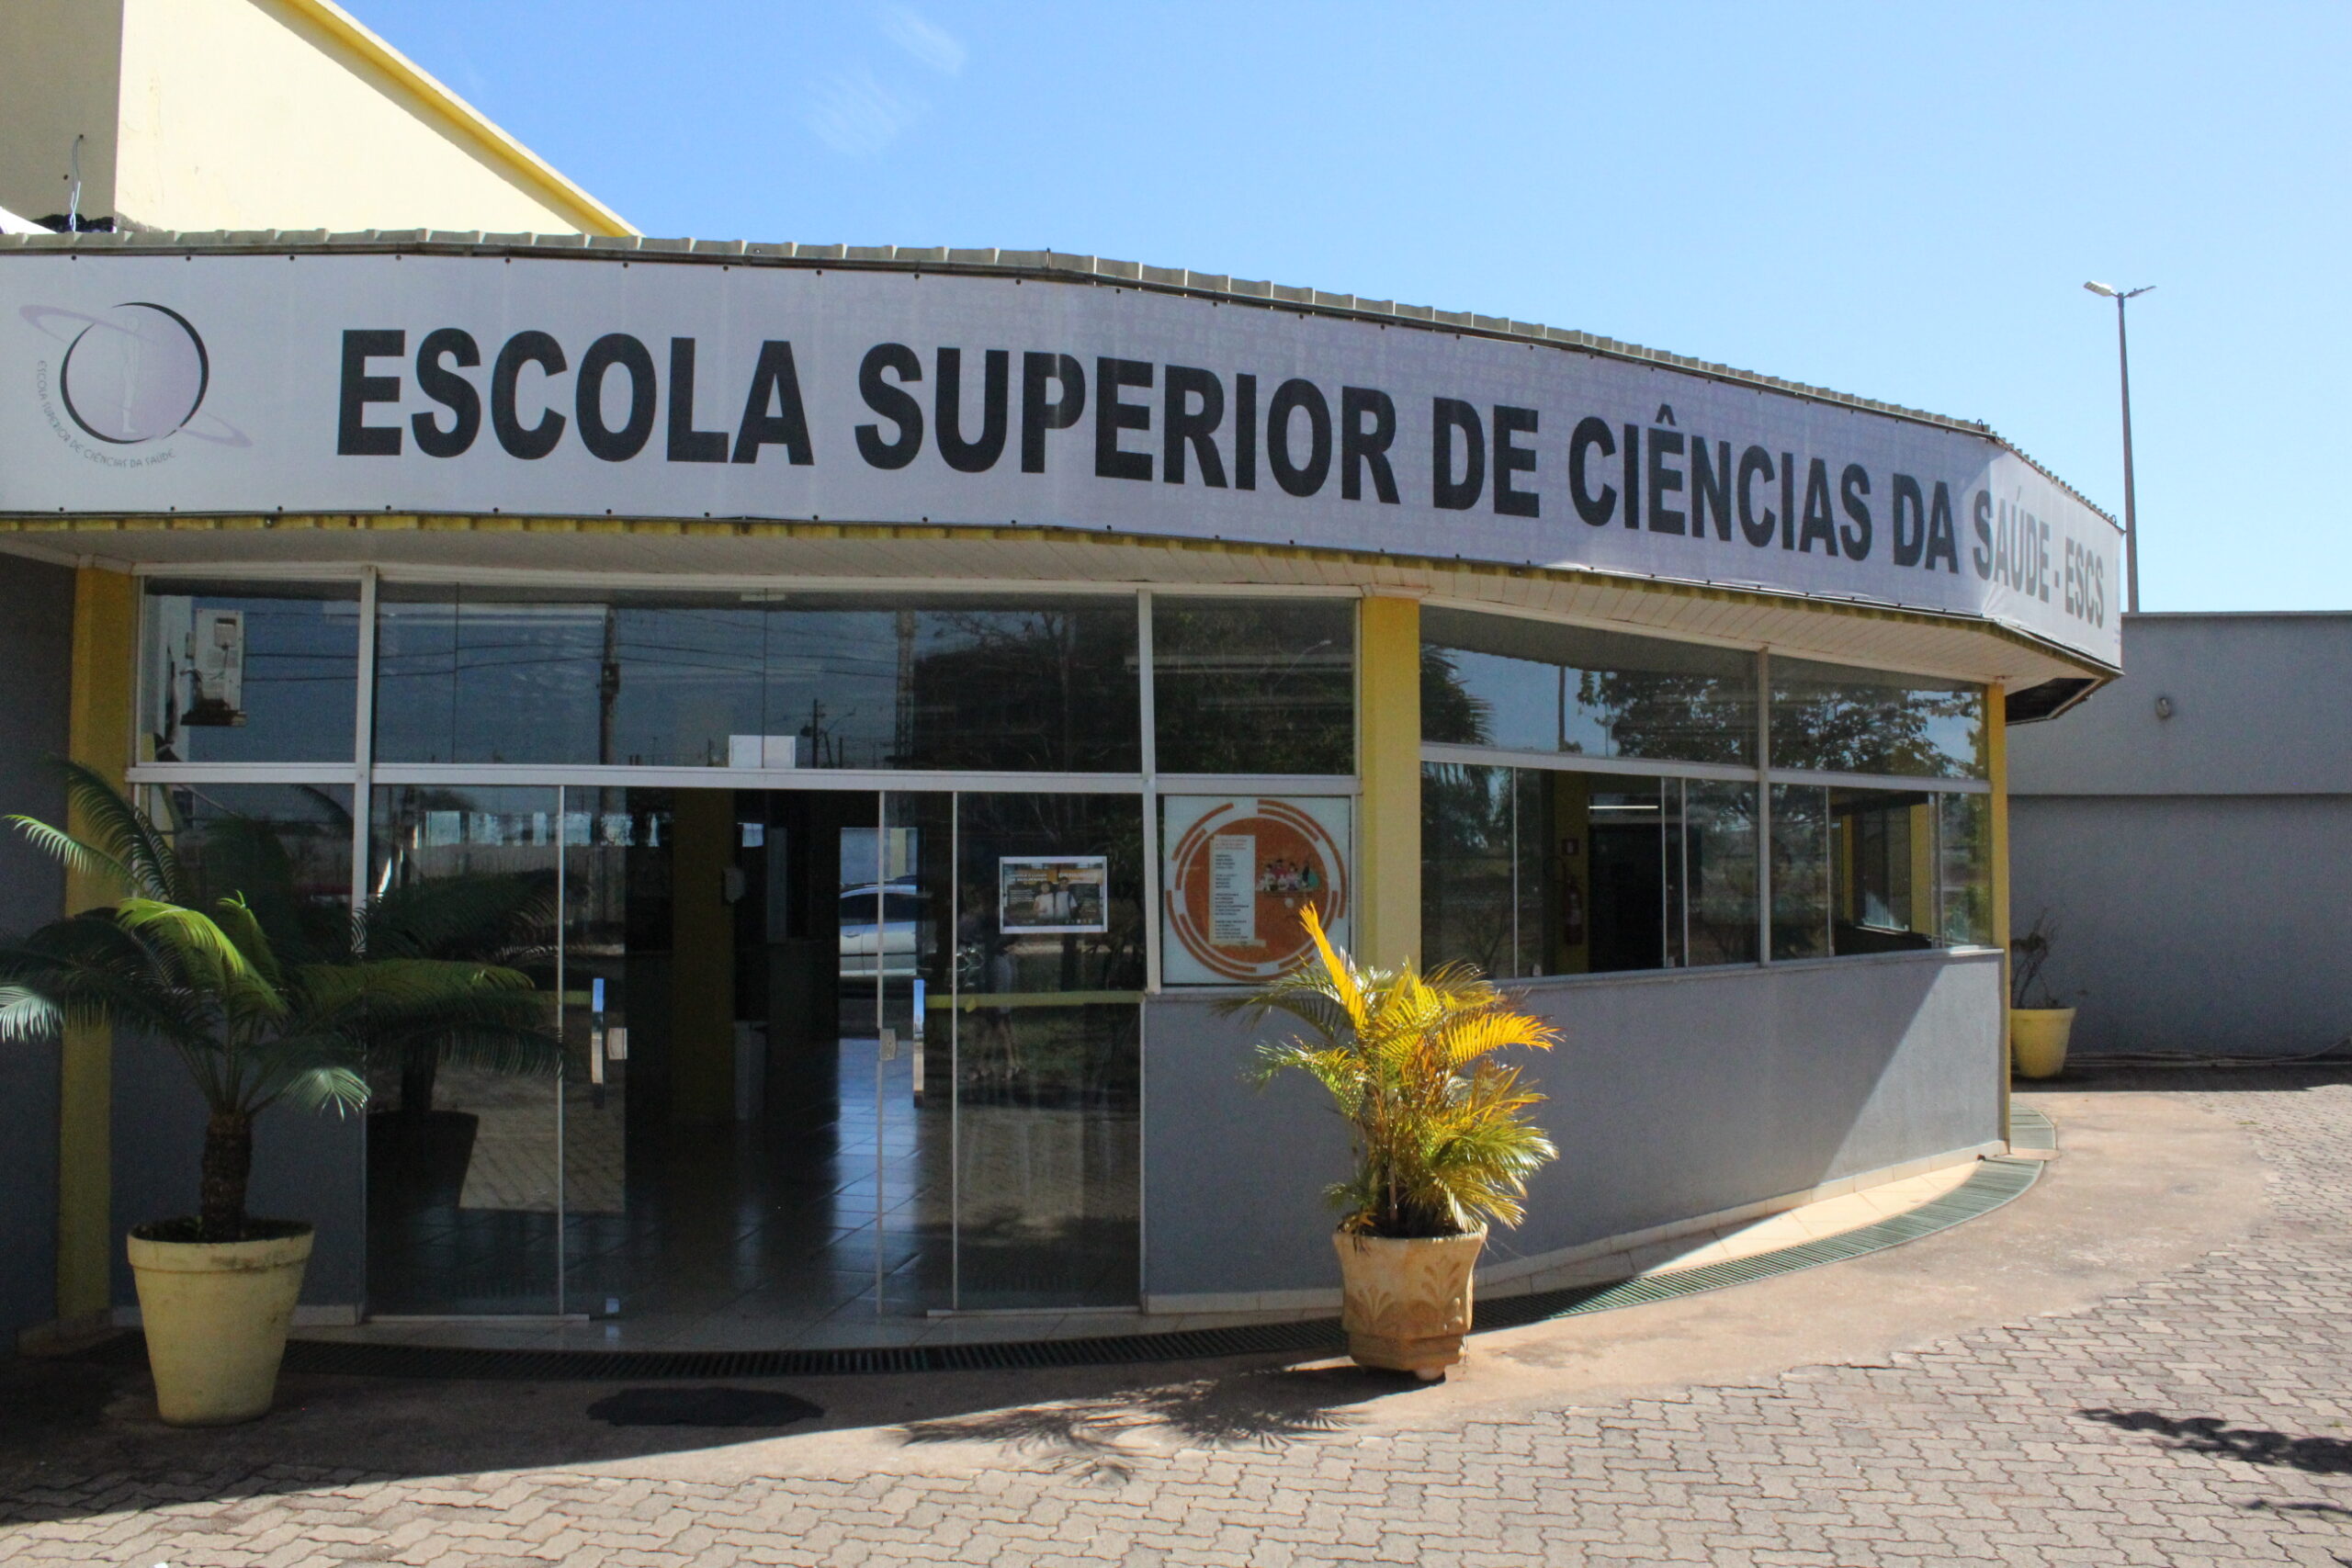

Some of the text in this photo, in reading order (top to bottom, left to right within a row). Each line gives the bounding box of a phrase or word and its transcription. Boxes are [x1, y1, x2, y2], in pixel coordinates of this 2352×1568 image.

[38, 360, 48, 400] ESCOLA
[43, 401, 71, 442] SUPERIOR
[70, 440, 84, 453] DE
[130, 458, 142, 468] DA
[338, 329, 814, 465] ESCOLA
[855, 344, 1400, 504] SUPERIOR
[1433, 397, 1539, 518] DE
[1569, 404, 1871, 560] CIÊNCIAS
[1894, 474, 1958, 573] DA
[1973, 486, 2050, 603] SAÚDE
[2065, 537, 2104, 628] ESCS
